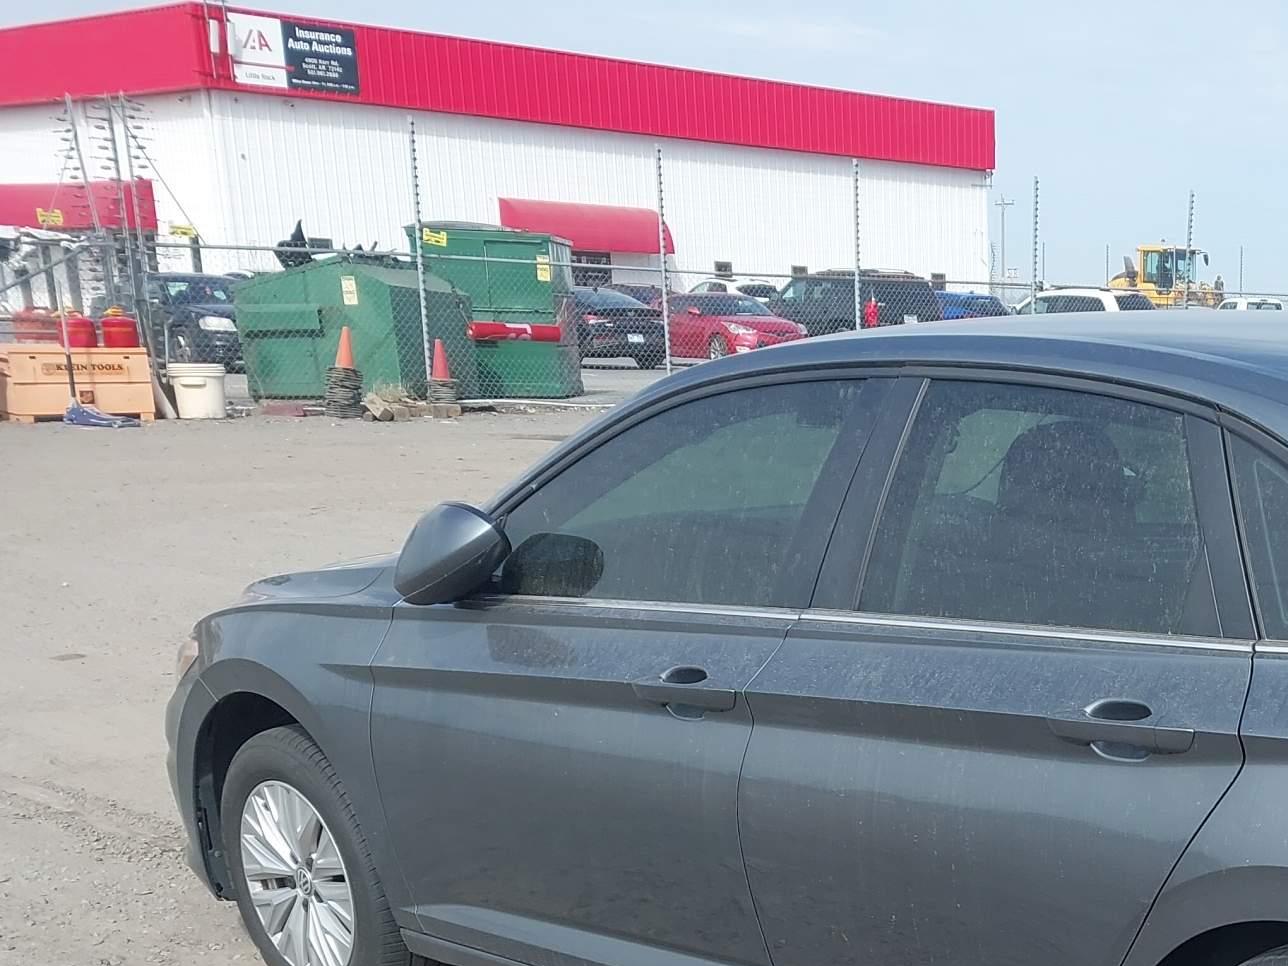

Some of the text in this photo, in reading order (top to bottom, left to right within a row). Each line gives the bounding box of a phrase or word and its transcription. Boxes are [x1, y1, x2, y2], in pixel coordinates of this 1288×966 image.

[295, 26, 342, 43] Insurance
[288, 37, 353, 56] Auto Auctions
[55, 363, 124, 371] KLIN TOOLS
